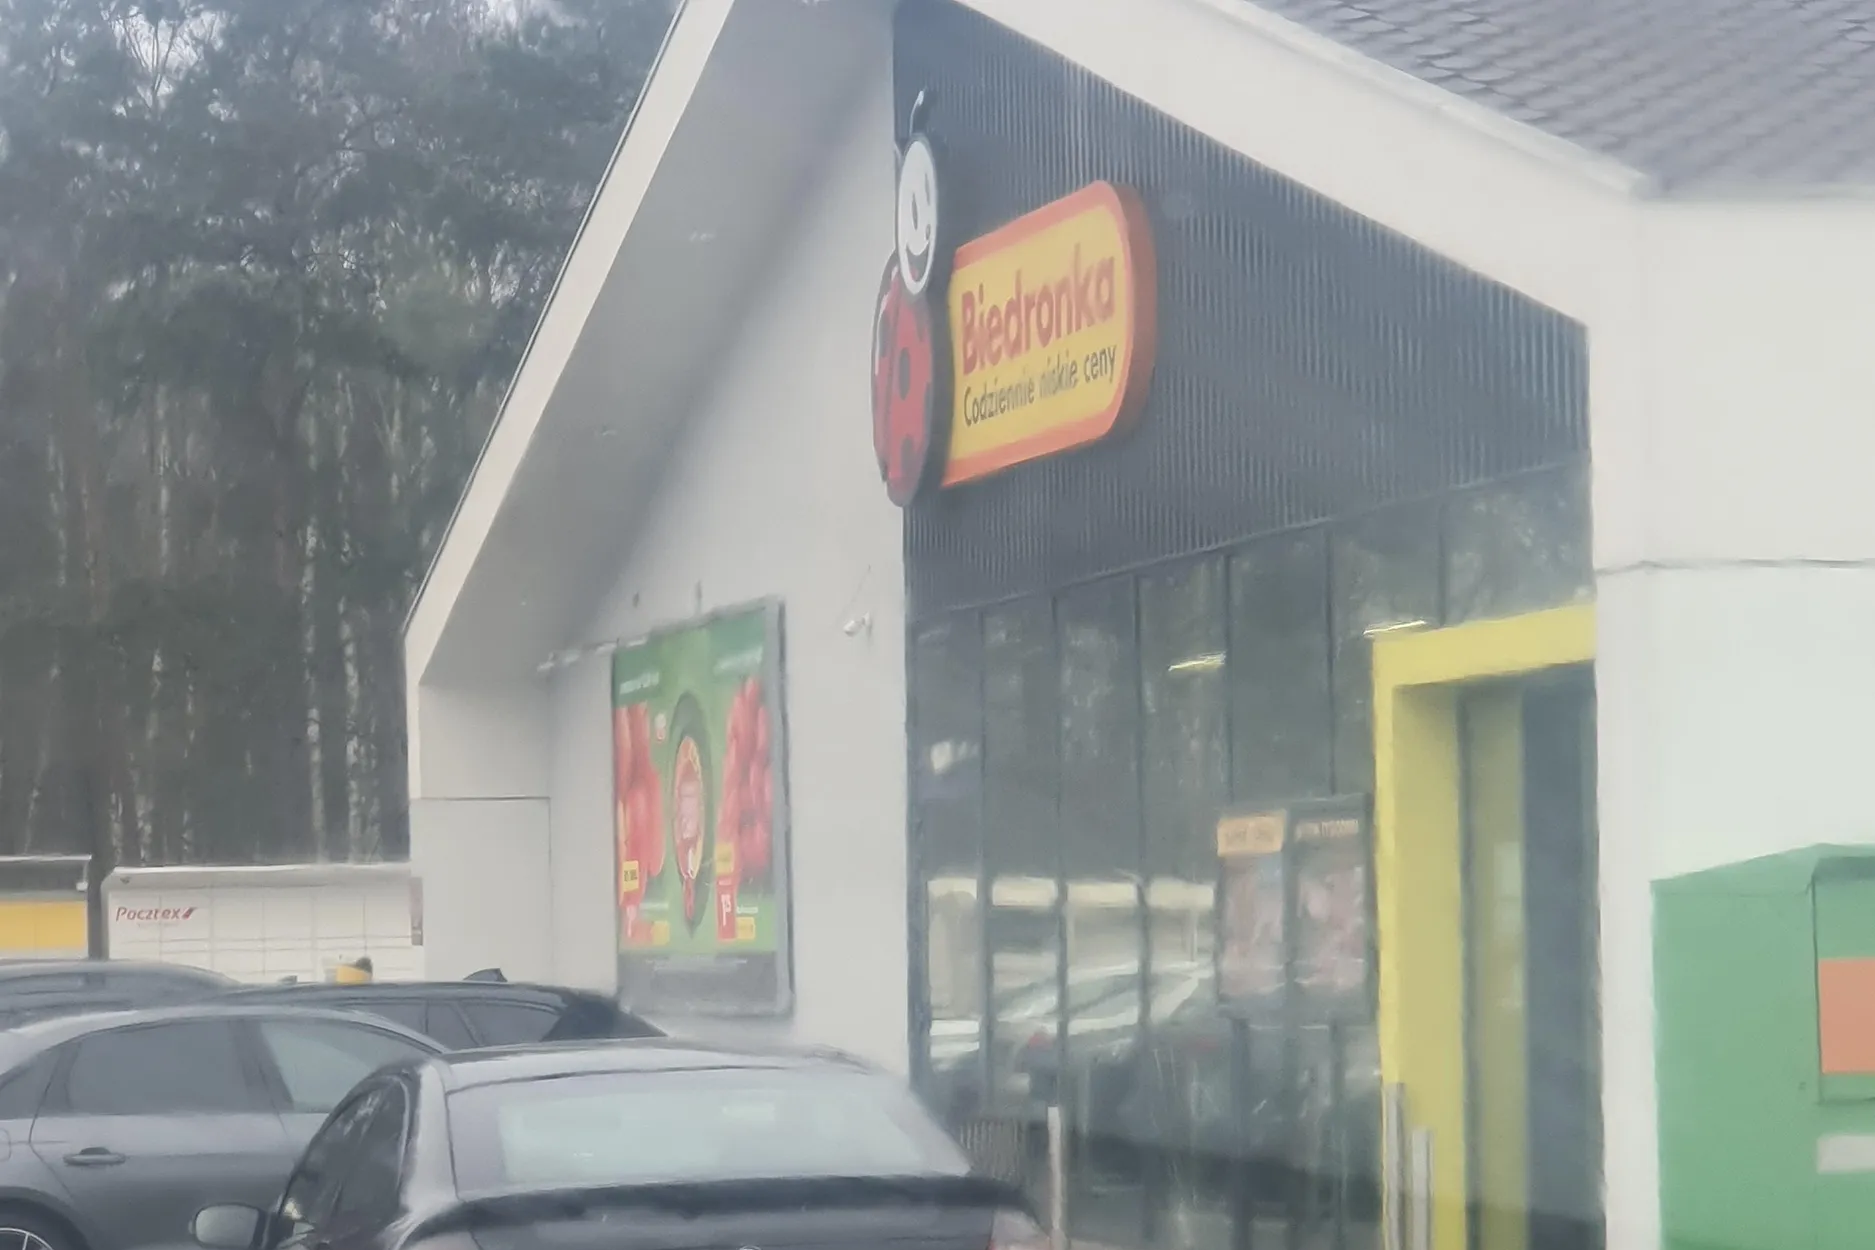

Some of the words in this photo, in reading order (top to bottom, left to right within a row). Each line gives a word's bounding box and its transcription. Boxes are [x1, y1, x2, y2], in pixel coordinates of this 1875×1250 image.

[961, 243, 1115, 375] Biedronka
[964, 364, 1035, 427] Codziennie
[1039, 349, 1079, 399] niskie
[1083, 345, 1117, 383] ceny
[115, 906, 181, 922] Pocztex
